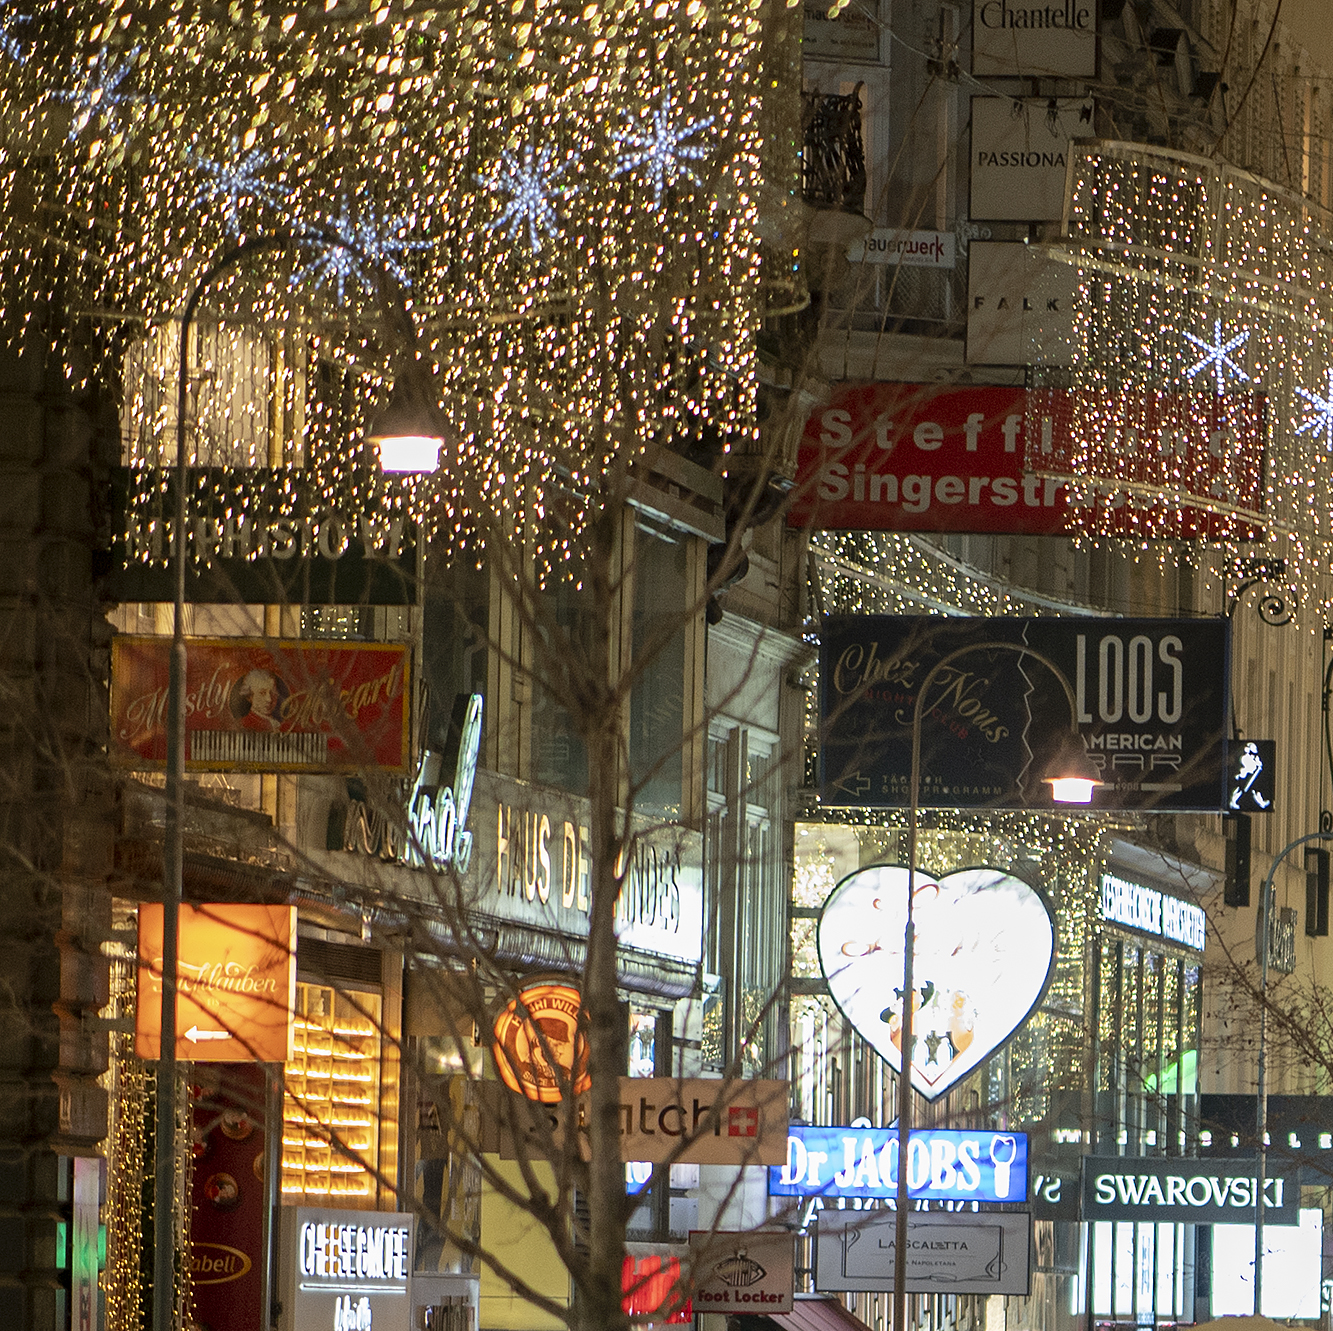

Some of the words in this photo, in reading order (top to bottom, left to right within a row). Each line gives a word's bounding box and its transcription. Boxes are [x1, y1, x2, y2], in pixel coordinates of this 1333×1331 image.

[980, 0, 1090, 29] Chantelle
[978, 152, 1065, 167] PASSIONA
[864, 235, 944, 262] auerwerk
[974, 297, 1059, 311] FALK
[820, 409, 1053, 452] Steffl
[833, 642, 920, 694] Chez
[1076, 634, 1183, 724] LOOS
[120, 662, 232, 738] Mstly
[895, 665, 1010, 743] Nous
[1087, 754, 1182, 770] BAR
[882, 786, 1001, 795] SHOPROGRAMM
[497, 803, 551, 905] HAUS
[562, 821, 592, 912] DE
[780, 1135, 828, 1186] Dr
[834, 1136, 981, 1191] JACOBS
[1095, 1174, 1285, 1208] SWAROVSKI
[191, 1253, 237, 1273] abell
[698, 1289, 730, 1303] Foot
[735, 1290, 785, 1303] Locker
